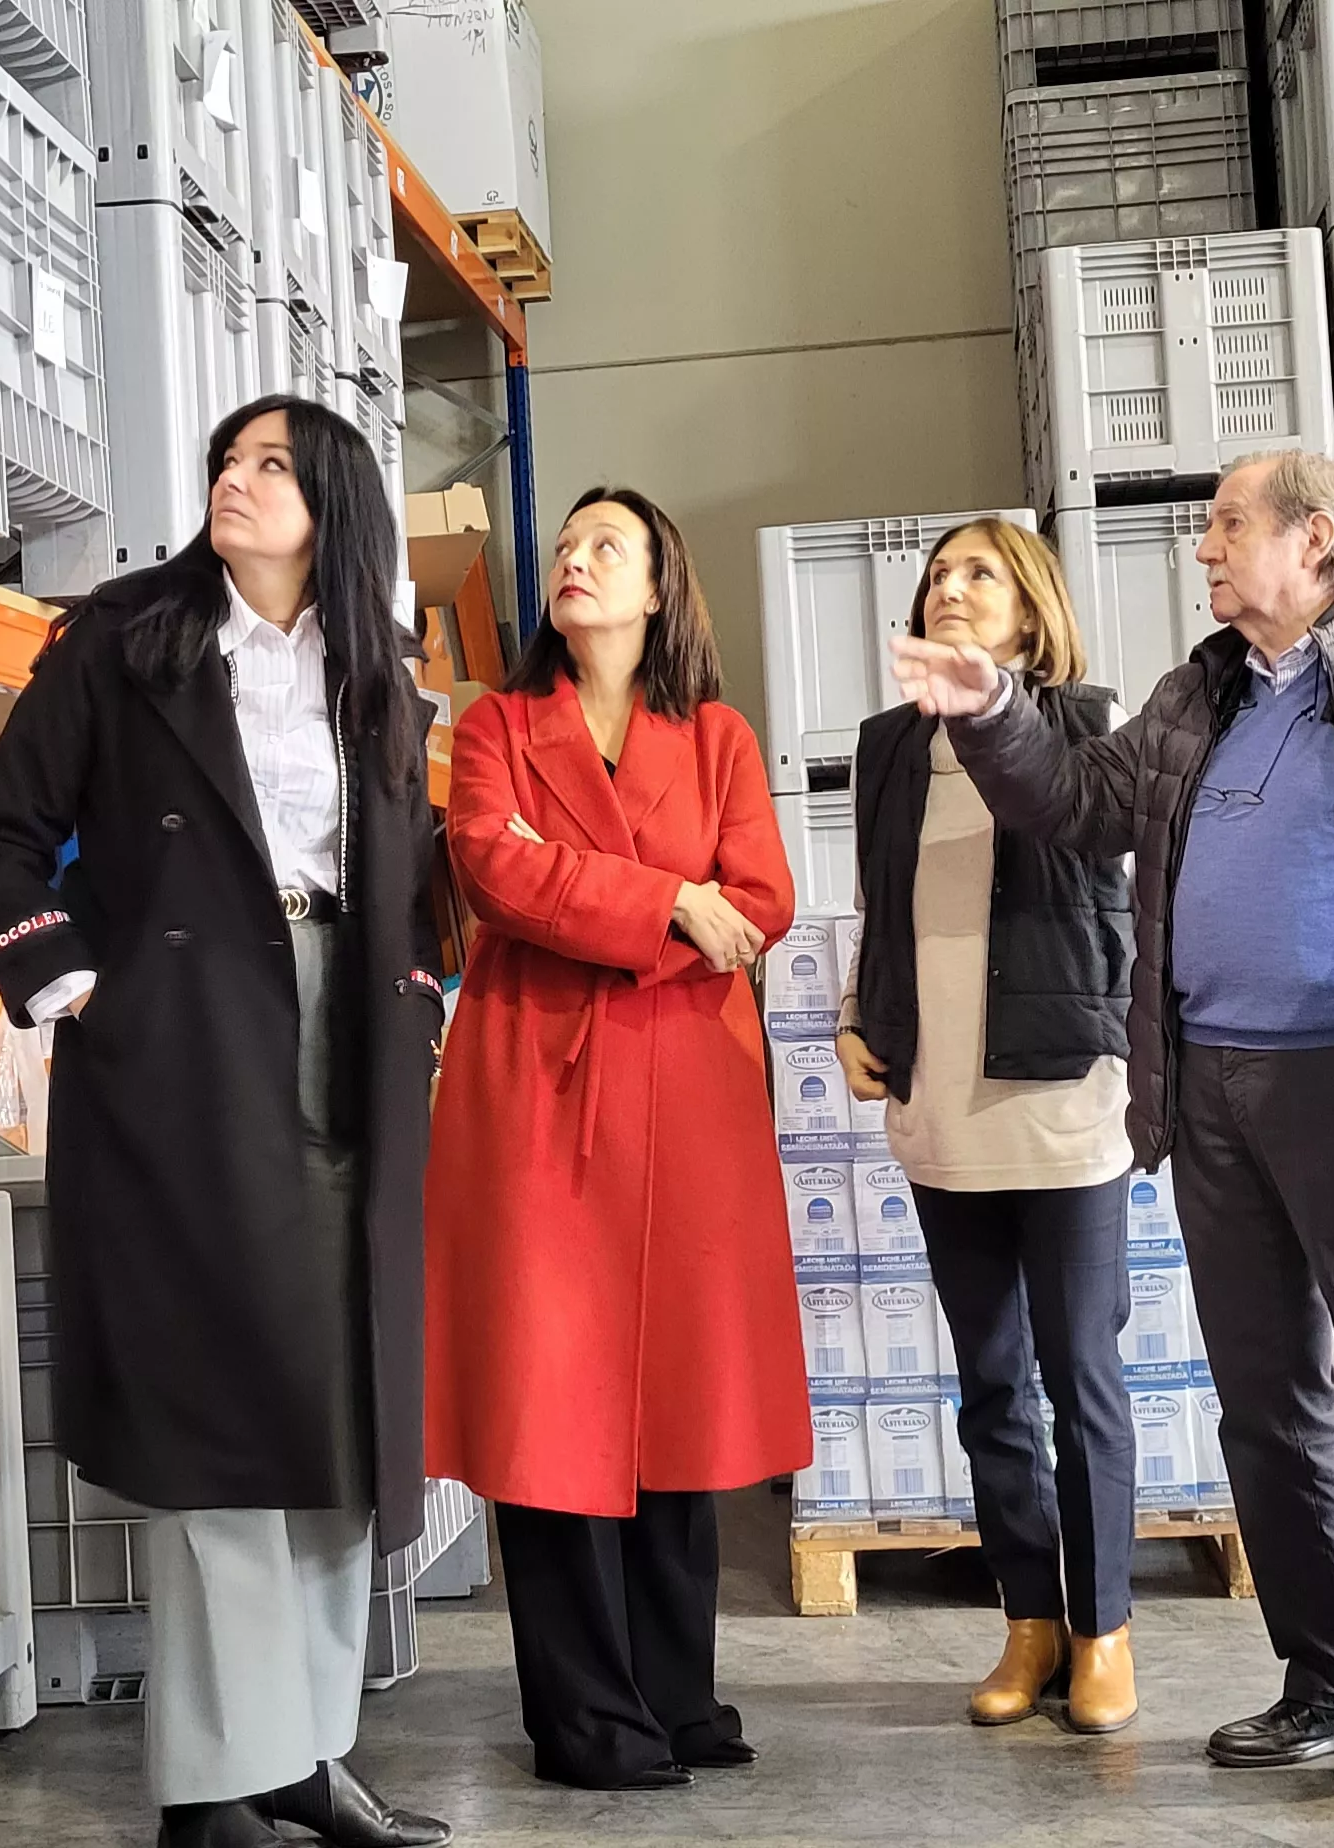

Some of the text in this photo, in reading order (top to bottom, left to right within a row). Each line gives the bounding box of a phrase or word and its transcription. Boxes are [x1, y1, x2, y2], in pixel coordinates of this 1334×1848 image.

[790, 1054, 834, 1065] ASTURIANA
[797, 1175, 842, 1186] ASTURIANA
[870, 1174, 906, 1185] ASTURIA
[793, 1264, 857, 1273] EMIDESNATADA
[1131, 1284, 1168, 1293] STURIANA
[805, 1296, 849, 1307] ASTURIANA
[876, 1296, 920, 1306] ASTURIANA
[1123, 1371, 1188, 1382] EMIDESNATADA
[1132, 1405, 1176, 1415] ASTURIANA
[882, 1417, 927, 1428] ASTURIANA
